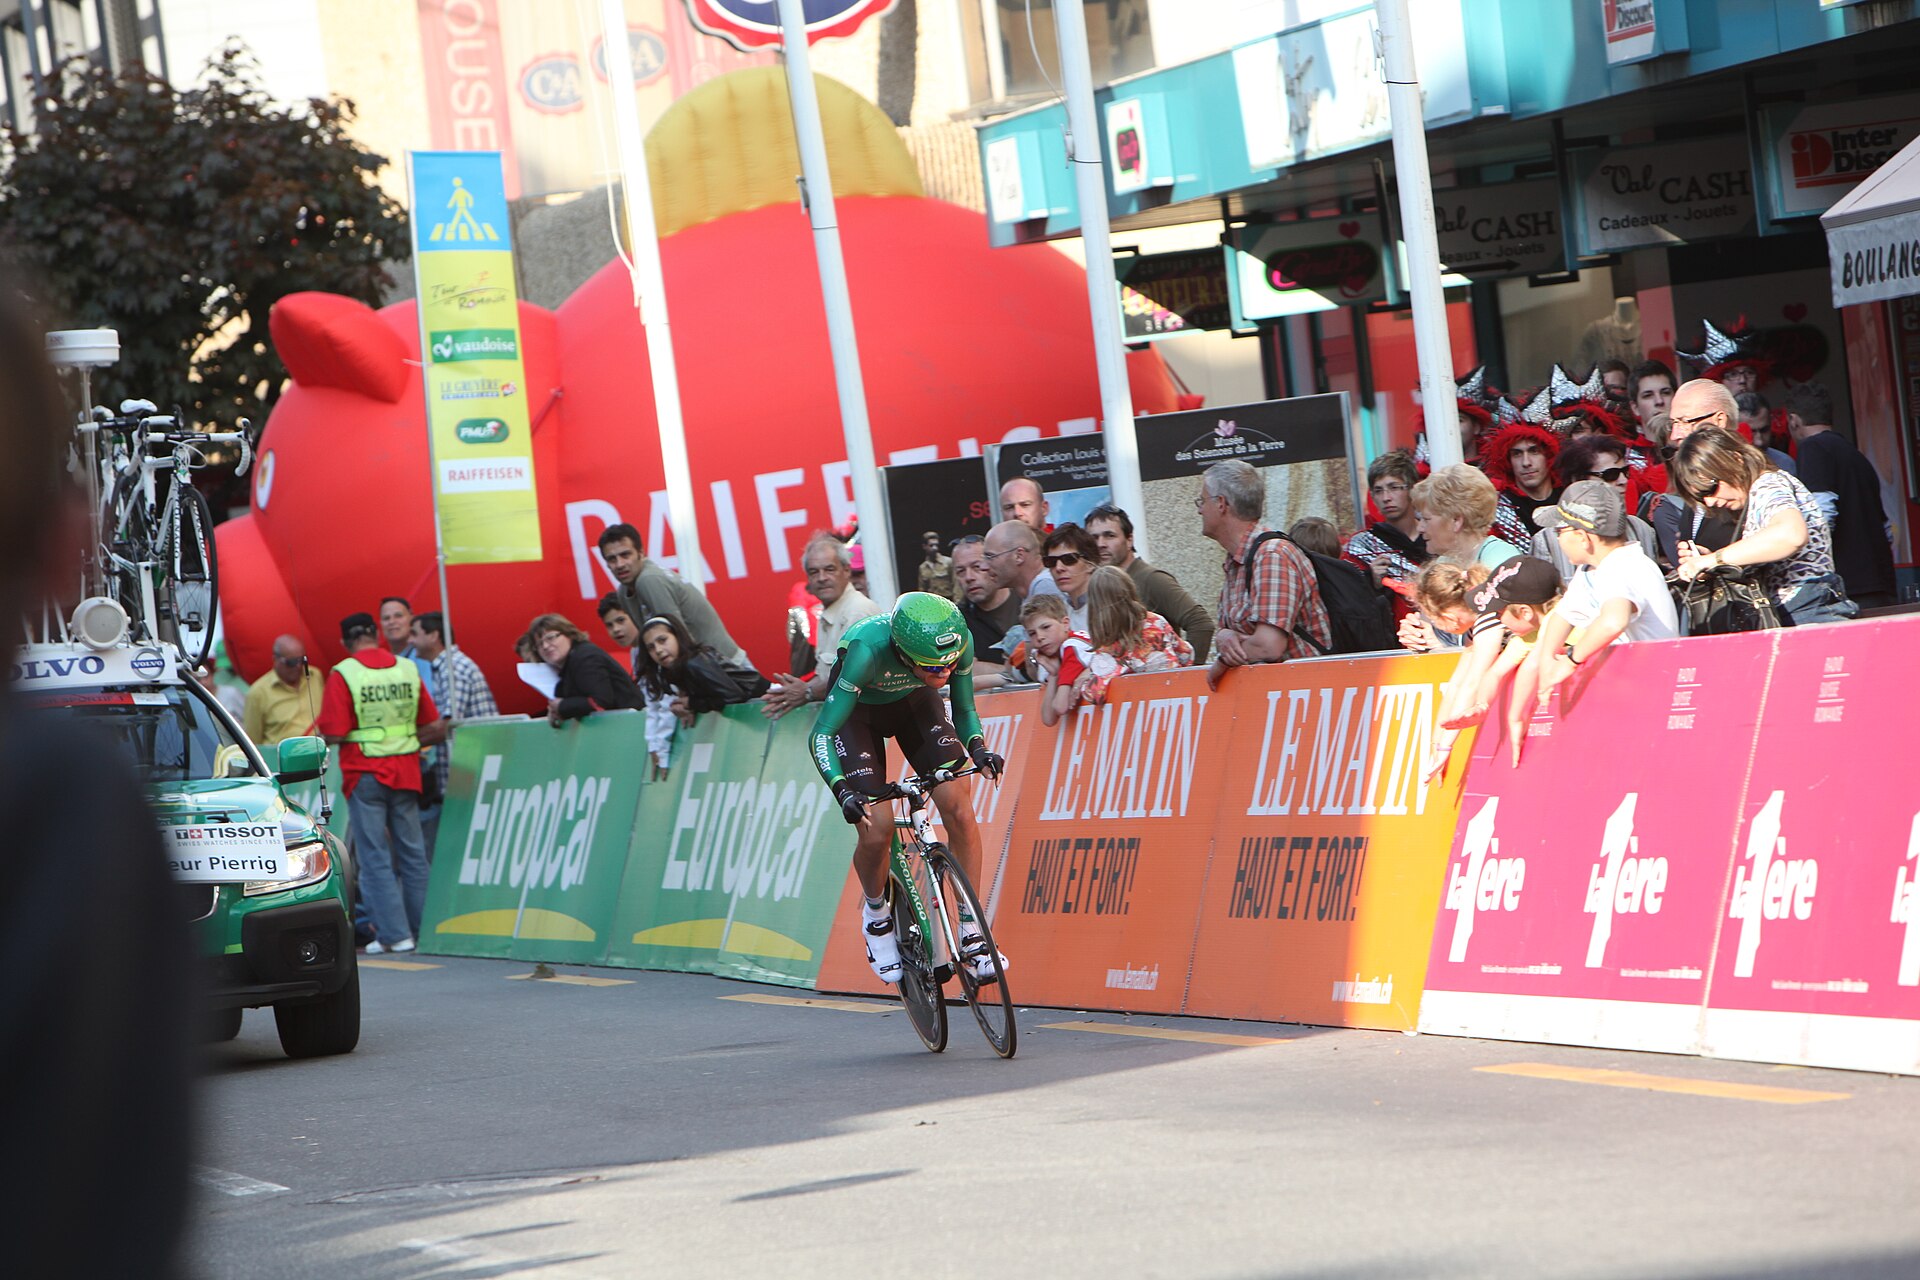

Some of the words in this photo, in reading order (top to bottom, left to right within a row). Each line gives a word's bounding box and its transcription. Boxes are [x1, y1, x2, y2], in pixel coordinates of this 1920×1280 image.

[1831, 127, 1898, 151] Inter
[1600, 164, 1655, 194] Val
[1659, 169, 1751, 204] CASH
[1471, 210, 1557, 242] CASH
[1598, 213, 1669, 231] Cadeaux
[1684, 204, 1738, 221] Jouets
[1496, 243, 1546, 258] Jouets
[1842, 239, 1920, 288] BOULANG
[454, 336, 516, 354] vaudoise
[1020, 451, 1073, 467] Collection
[1074, 448, 1100, 460] Louis
[1175, 451, 1193, 461] des
[448, 467, 524, 482] RAIFFEISEN
[132, 660, 164, 669] VOLVO
[1039, 704, 1095, 821] LE
[1081, 695, 1209, 819] MATIN
[1246, 689, 1311, 816] LE
[1297, 683, 1452, 816] MATIN
[203, 826, 278, 839] TISSOT
[458, 755, 611, 938] Europcar
[662, 743, 832, 951] Europcar
[169, 859, 202, 871] eur
[209, 856, 277, 874] Pierrig
[1021, 838, 1071, 914] HAUT
[1062, 838, 1093, 914] ET
[1084, 837, 1141, 916] FORT!
[1228, 837, 1287, 919] HAUT
[1277, 837, 1313, 920] ET
[1304, 836, 1370, 922] FORT!
[899, 860, 927, 921] COLNAGO
